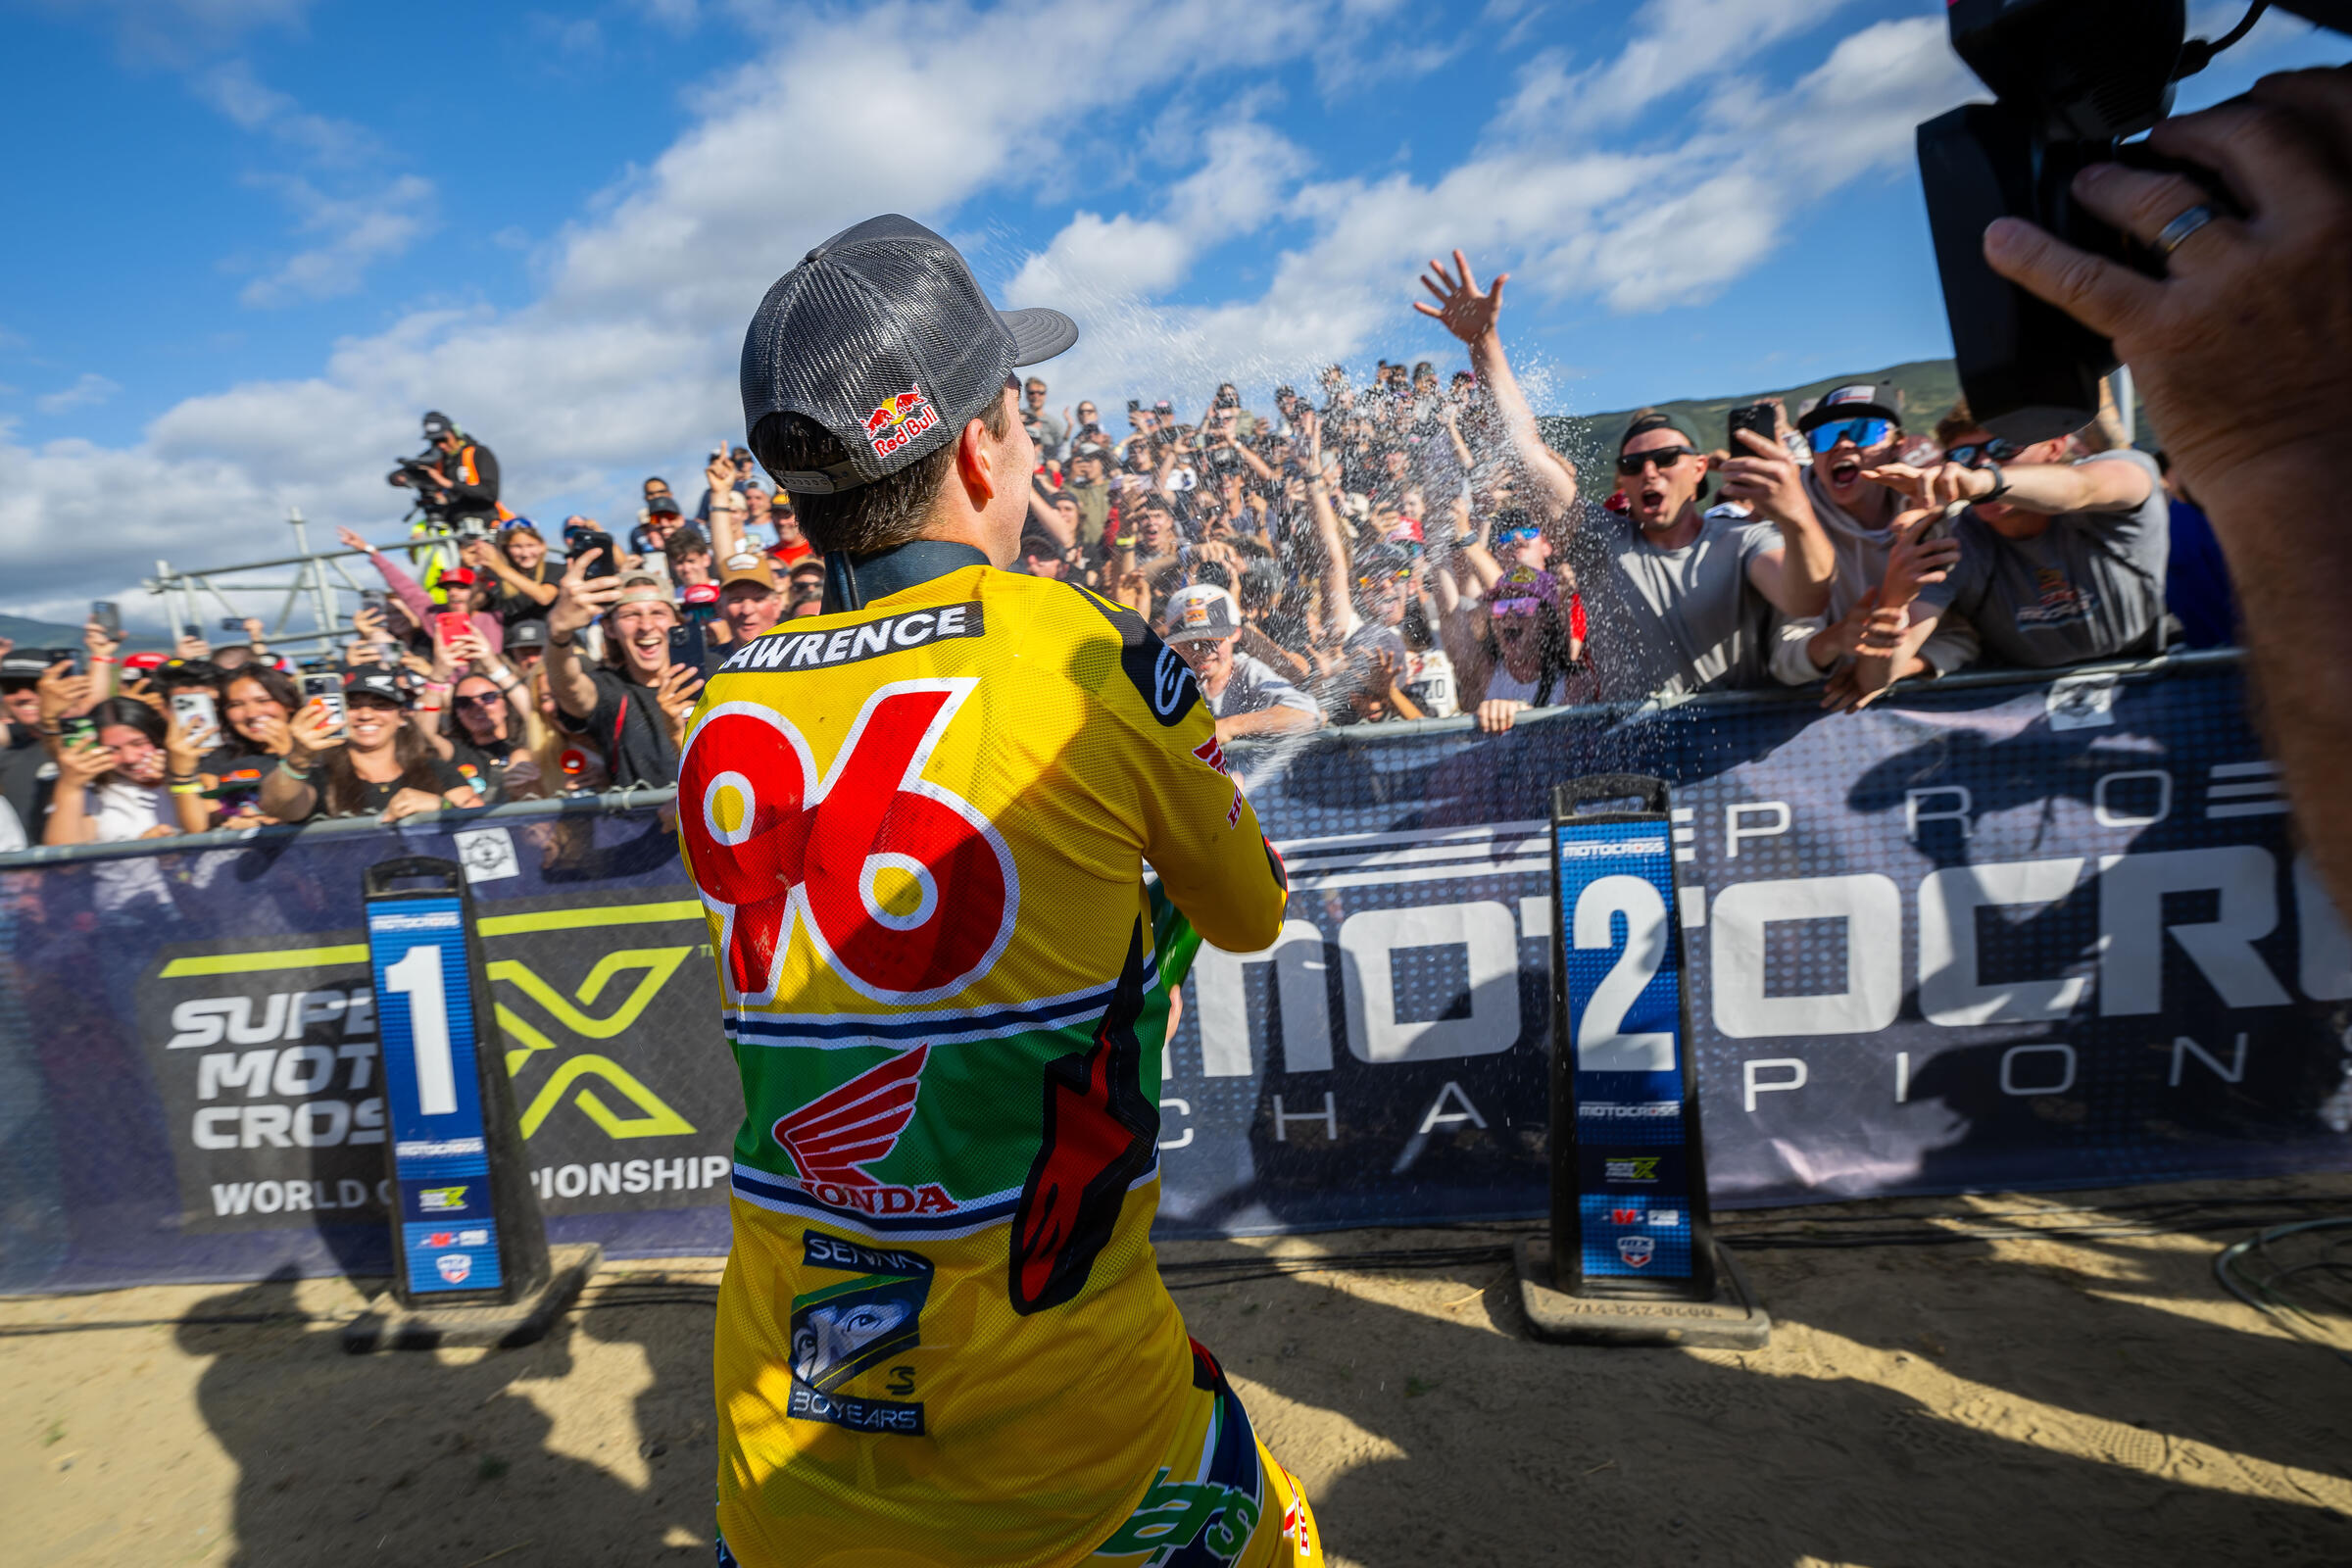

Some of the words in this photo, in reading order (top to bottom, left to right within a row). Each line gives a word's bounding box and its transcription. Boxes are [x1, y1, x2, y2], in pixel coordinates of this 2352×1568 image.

[872, 425, 909, 458] Red
[904, 404, 939, 437] Bull
[717, 607, 966, 670] AWRENCE
[677, 677, 1019, 1005] 96
[1562, 840, 1666, 858] MOTOCROSS
[1160, 846, 2352, 1079] MOOCR
[1573, 874, 1676, 1072] 2
[166, 987, 377, 1050] SUPE
[385, 945, 459, 1115] 1
[198, 1043, 378, 1100] MOT
[192, 1097, 386, 1150] CROS
[1578, 1104, 1681, 1117] MOTOCROSS
[211, 1179, 368, 1216] WORLD
[808, 1238, 927, 1270] SENNA
